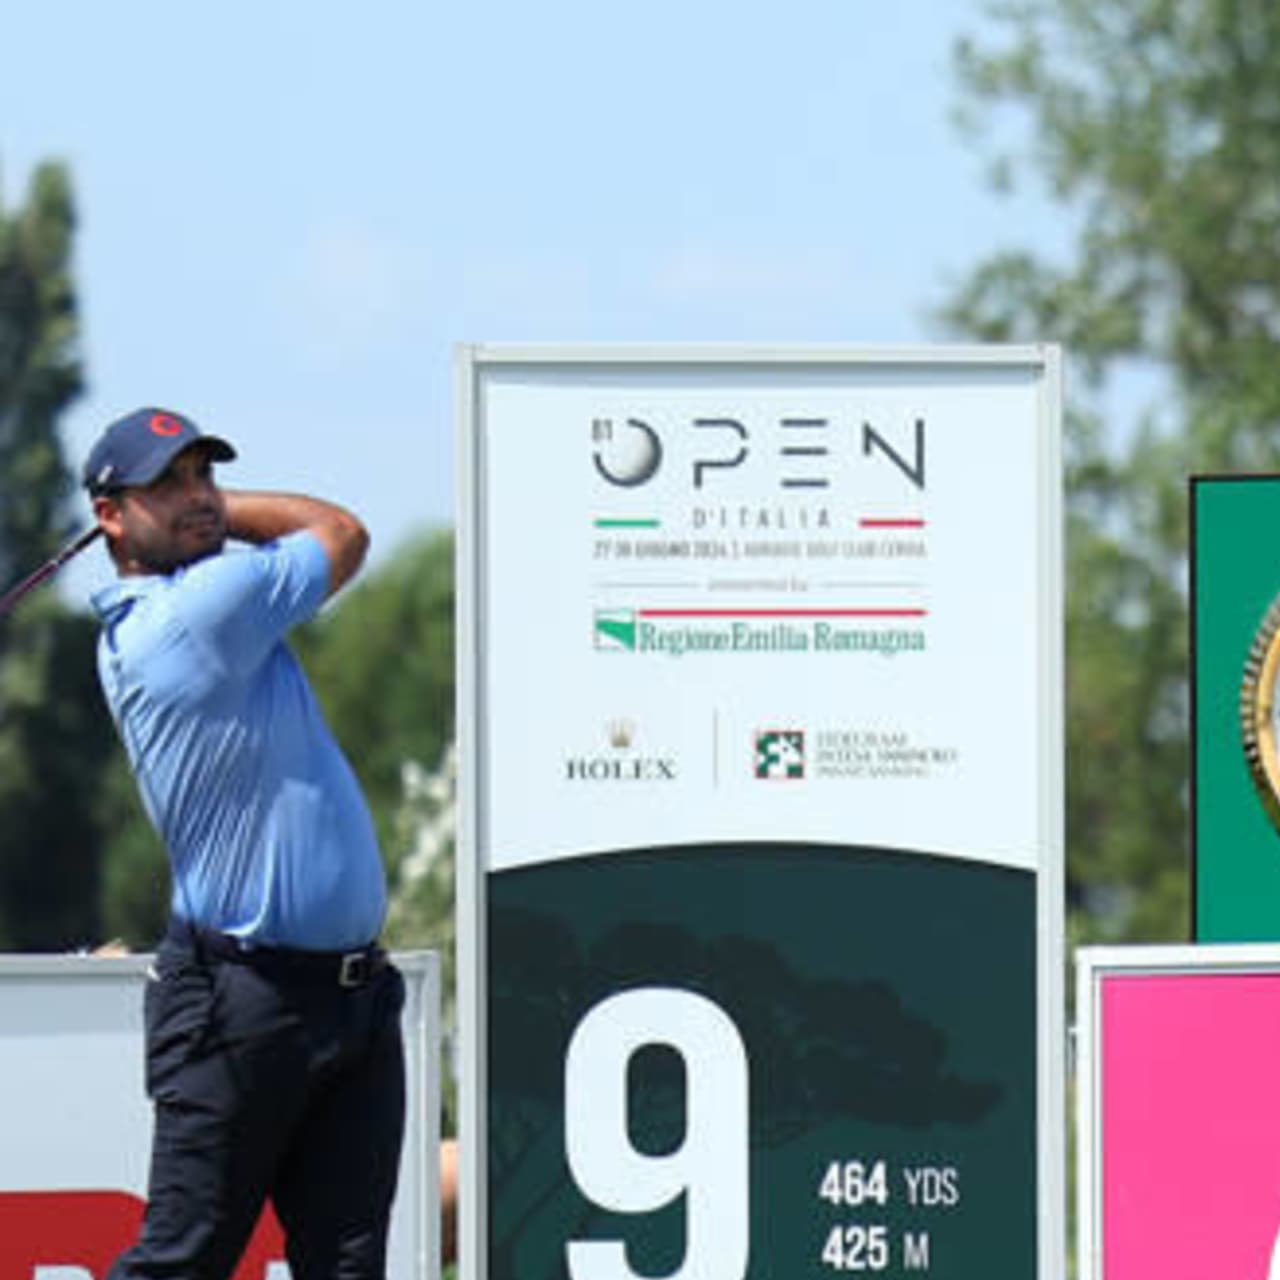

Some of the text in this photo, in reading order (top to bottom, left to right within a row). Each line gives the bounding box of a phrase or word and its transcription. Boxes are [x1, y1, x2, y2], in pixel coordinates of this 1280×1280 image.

[592, 418, 925, 489] OPEN
[693, 506, 831, 529] D'ITALIA
[819, 1161, 960, 1206] 464 YDS
[821, 1224, 930, 1270] 425 M
